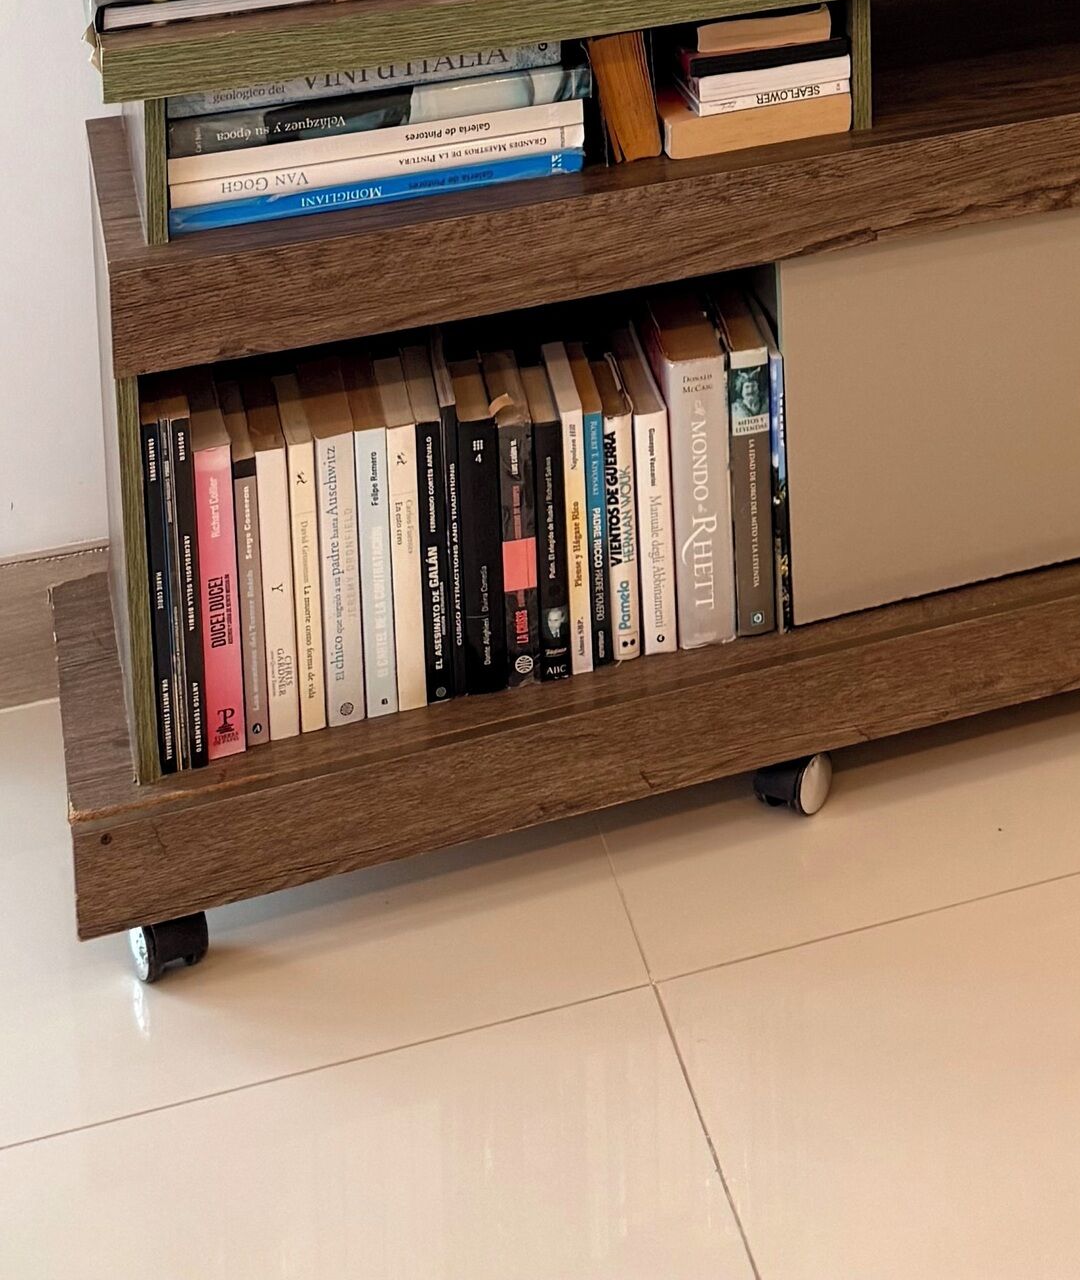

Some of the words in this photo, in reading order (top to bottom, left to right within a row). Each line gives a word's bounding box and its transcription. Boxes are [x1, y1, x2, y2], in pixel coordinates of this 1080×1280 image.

[756, 85, 820, 105] SEAFLOWER
[216, 128, 252, 142] época
[255, 127, 270, 136] su
[273, 126, 283, 134] y
[284, 115, 346, 131] Velázquez
[405, 128, 442, 141] Pintores
[445, 125, 457, 135] de
[439, 151, 449, 159] LA
[450, 149, 462, 157] DE
[464, 143, 507, 155] MAESTROS
[509, 137, 547, 149] GRANDES
[398, 153, 438, 166] PINTURA
[221, 176, 269, 194] GOGH
[275, 171, 309, 187] VAN
[301, 186, 382, 208] MODIGLIANI
[590, 421, 598, 450] ROBERT
[648, 428, 656, 456] Giuseppe
[369, 451, 379, 481] Romero
[570, 439, 578, 470] Napoleon
[604, 431, 618, 486] GUERRA
[691, 420, 709, 501] MONDO
[748, 449, 756, 471] EDAD
[323, 446, 339, 516] Auschwitz
[619, 465, 631, 508] WOUK
[371, 483, 380, 506] Felipe
[607, 487, 619, 505] DE
[395, 502, 403, 512] En
[428, 496, 436, 532] FERNANDO
[571, 501, 580, 520] Rico
[649, 495, 662, 539] Manuale
[750, 501, 758, 515] DEL
[209, 504, 220, 538] Richard
[300, 520, 309, 543] David
[592, 507, 601, 538] PADRE
[245, 533, 254, 559] Serge
[344, 508, 355, 571] DRONFIELD
[395, 529, 403, 545] creo
[573, 522, 582, 552] Hágase
[607, 506, 623, 567] VIENTOS
[620, 509, 634, 563] HERMAN
[326, 541, 344, 576] padre
[593, 539, 603, 567] RICCO
[648, 540, 664, 564] degli
[682, 514, 717, 609] RHETT
[426, 546, 439, 588] GALÁN
[453, 544, 461, 610] ATTRACTIONS
[574, 559, 582, 587] Piense
[208, 576, 224, 610] DUCE!
[303, 585, 312, 595] La
[595, 569, 604, 593] PADRE
[432, 590, 440, 602] DE
[617, 580, 631, 630] Pamela
[650, 566, 666, 628] Abbinamenti
[304, 597, 312, 623] muerte
[209, 613, 226, 648] DUCE!
[305, 625, 313, 646] como
[335, 620, 345, 634] que
[432, 604, 442, 656] ASESINATO
[455, 611, 463, 646] CUSCO
[516, 634, 529, 644] LA
[306, 647, 315, 670] forma
[330, 636, 345, 670] chico
[435, 658, 443, 670] EL
[483, 646, 491, 665] Dante
[277, 648, 287, 697] GARDNER
[285, 655, 294, 686] CHRIS
[307, 672, 315, 681] de
[335, 671, 344, 680] El
[192, 682, 200, 707] ANTICO
[308, 682, 316, 699] vida
